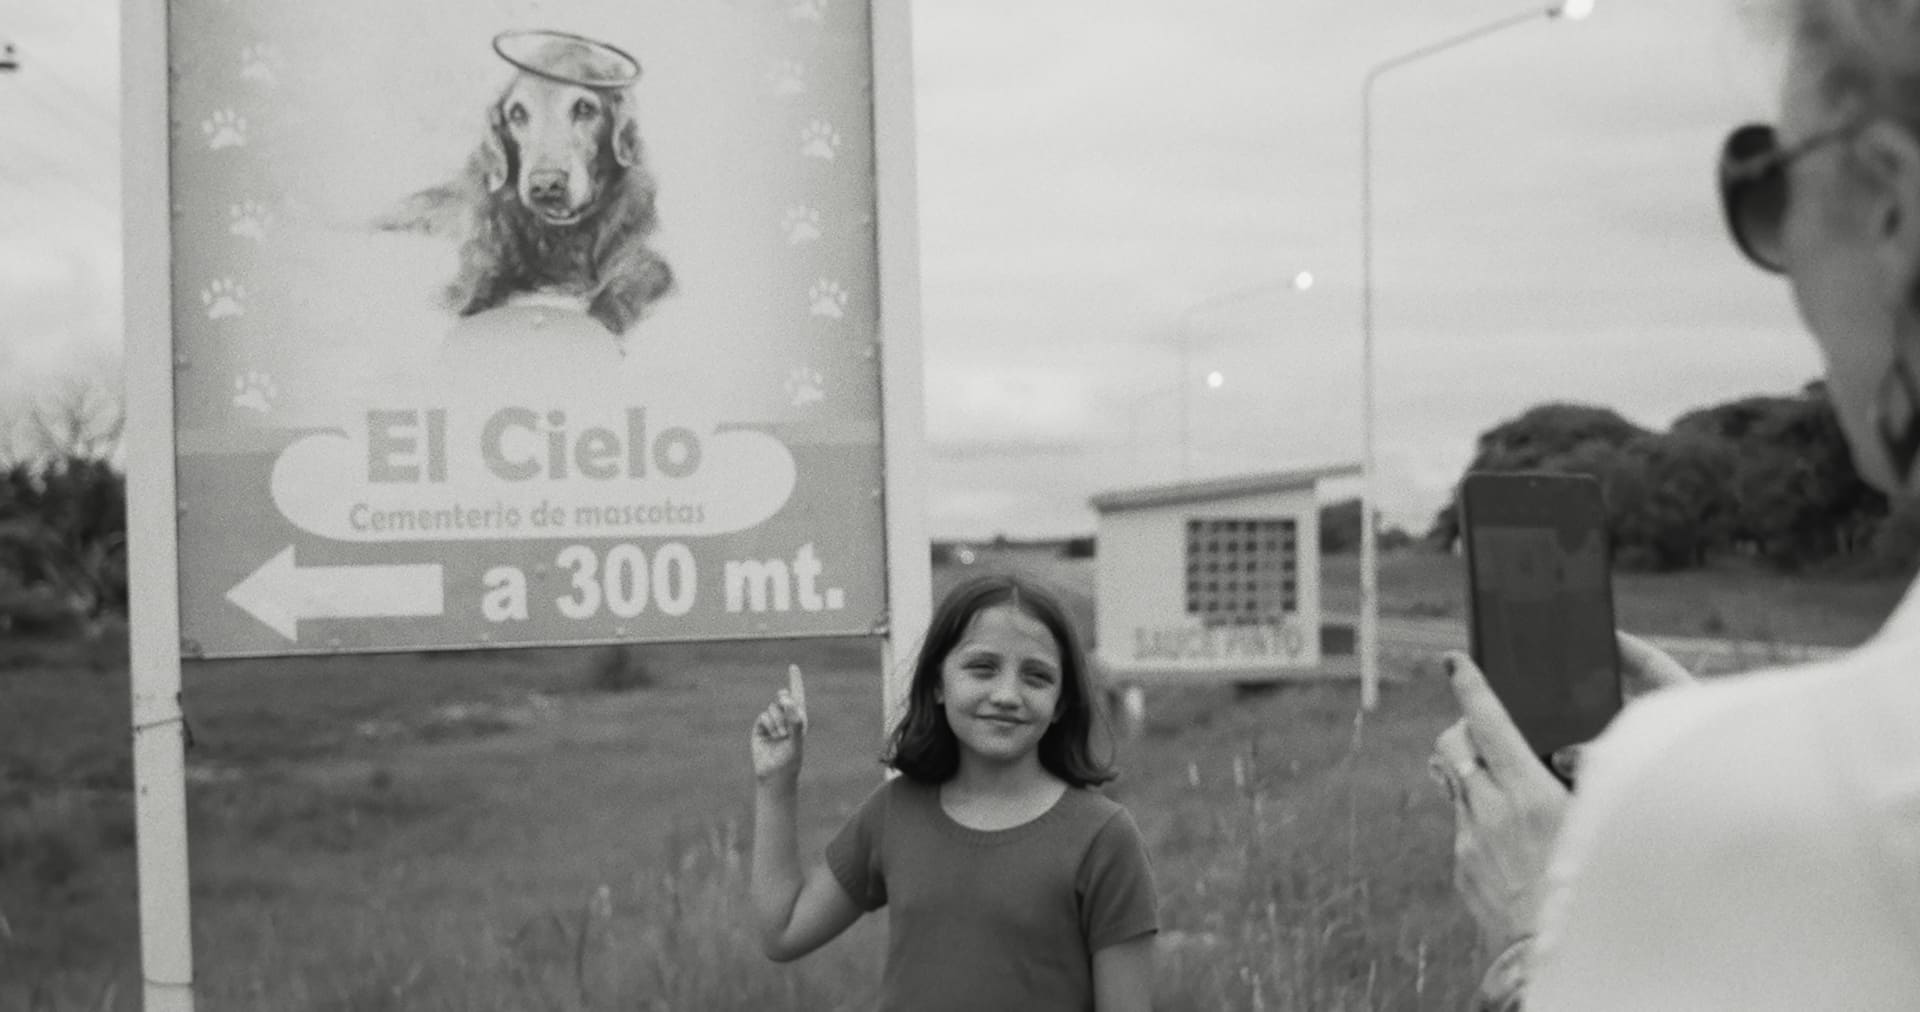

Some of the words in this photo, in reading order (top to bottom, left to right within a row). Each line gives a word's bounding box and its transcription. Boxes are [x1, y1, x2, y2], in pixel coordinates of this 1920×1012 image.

[366, 408, 448, 482] El
[480, 405, 702, 482] Cielo
[349, 502, 523, 531] Cementerio
[529, 500, 566, 527] de
[574, 498, 705, 526] mascotas
[481, 565, 529, 622] a
[556, 542, 697, 619] 300
[724, 543, 845, 614] mt.
